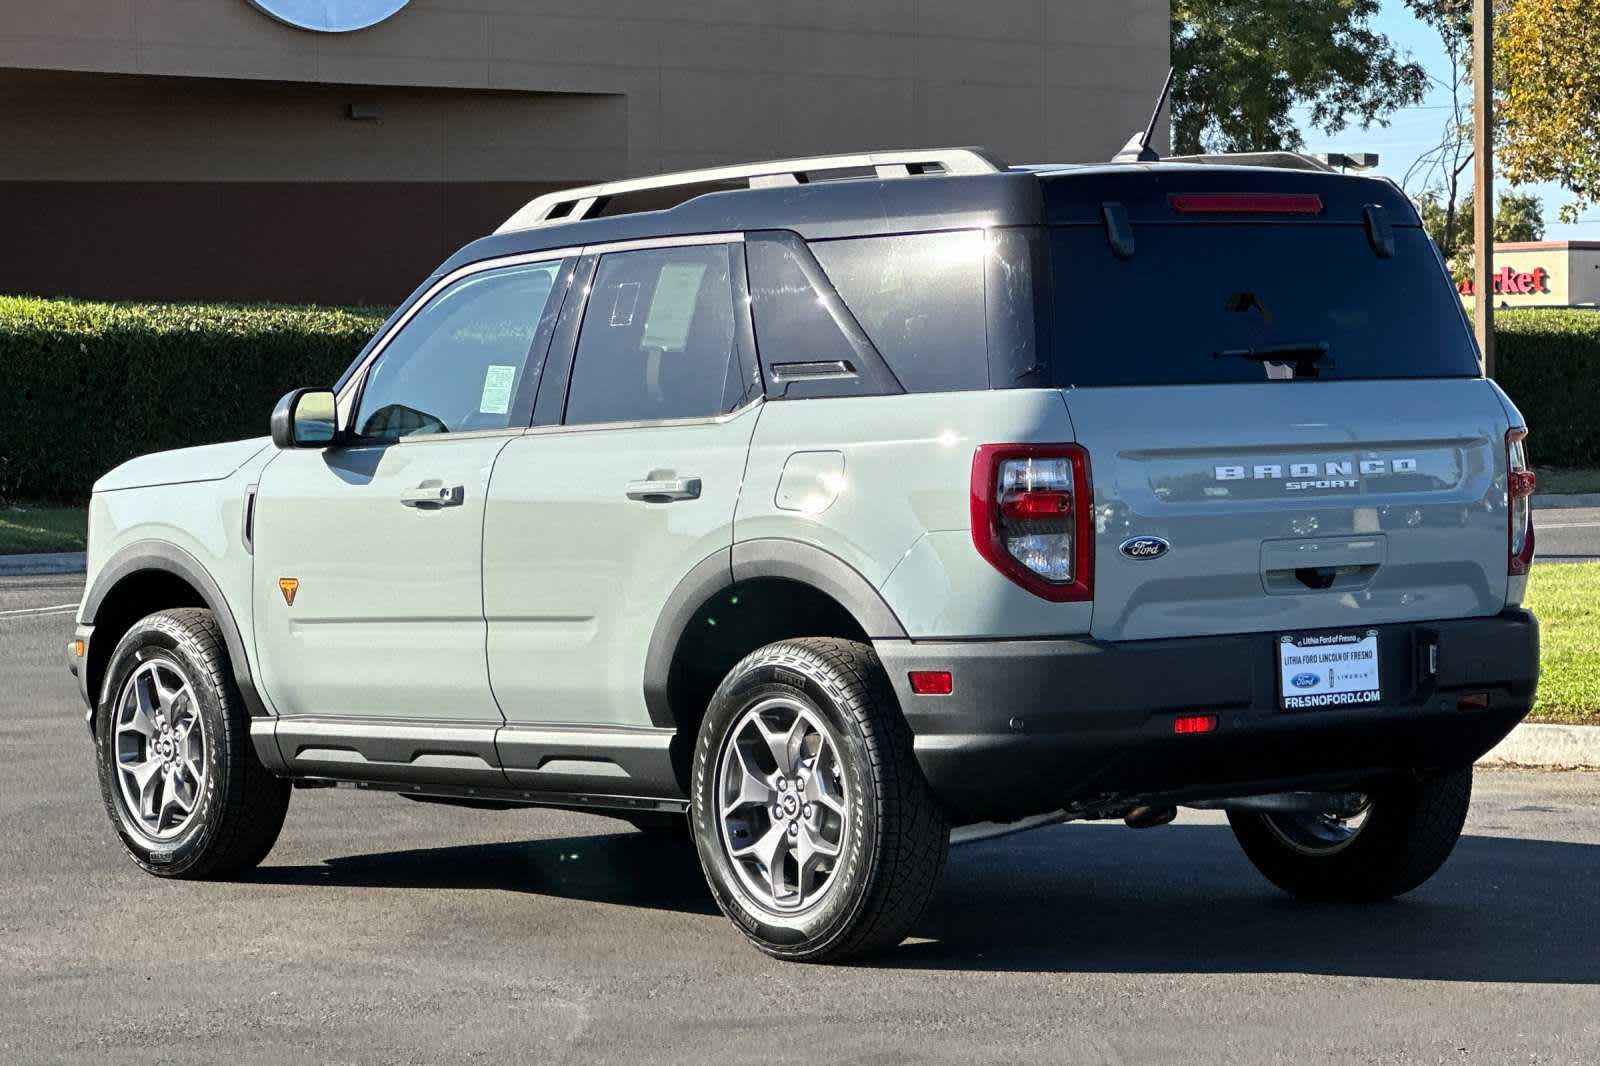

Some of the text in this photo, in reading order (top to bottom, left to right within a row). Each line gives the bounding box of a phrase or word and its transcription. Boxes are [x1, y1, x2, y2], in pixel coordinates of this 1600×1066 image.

[1214, 458, 1418, 480] BRONCO
[1286, 479, 1358, 490] SPORT
[1284, 650, 1373, 666] LITHIA FORD LINCOLN OF FRESNO
[1285, 691, 1380, 709] FRESNOFORD.COM
